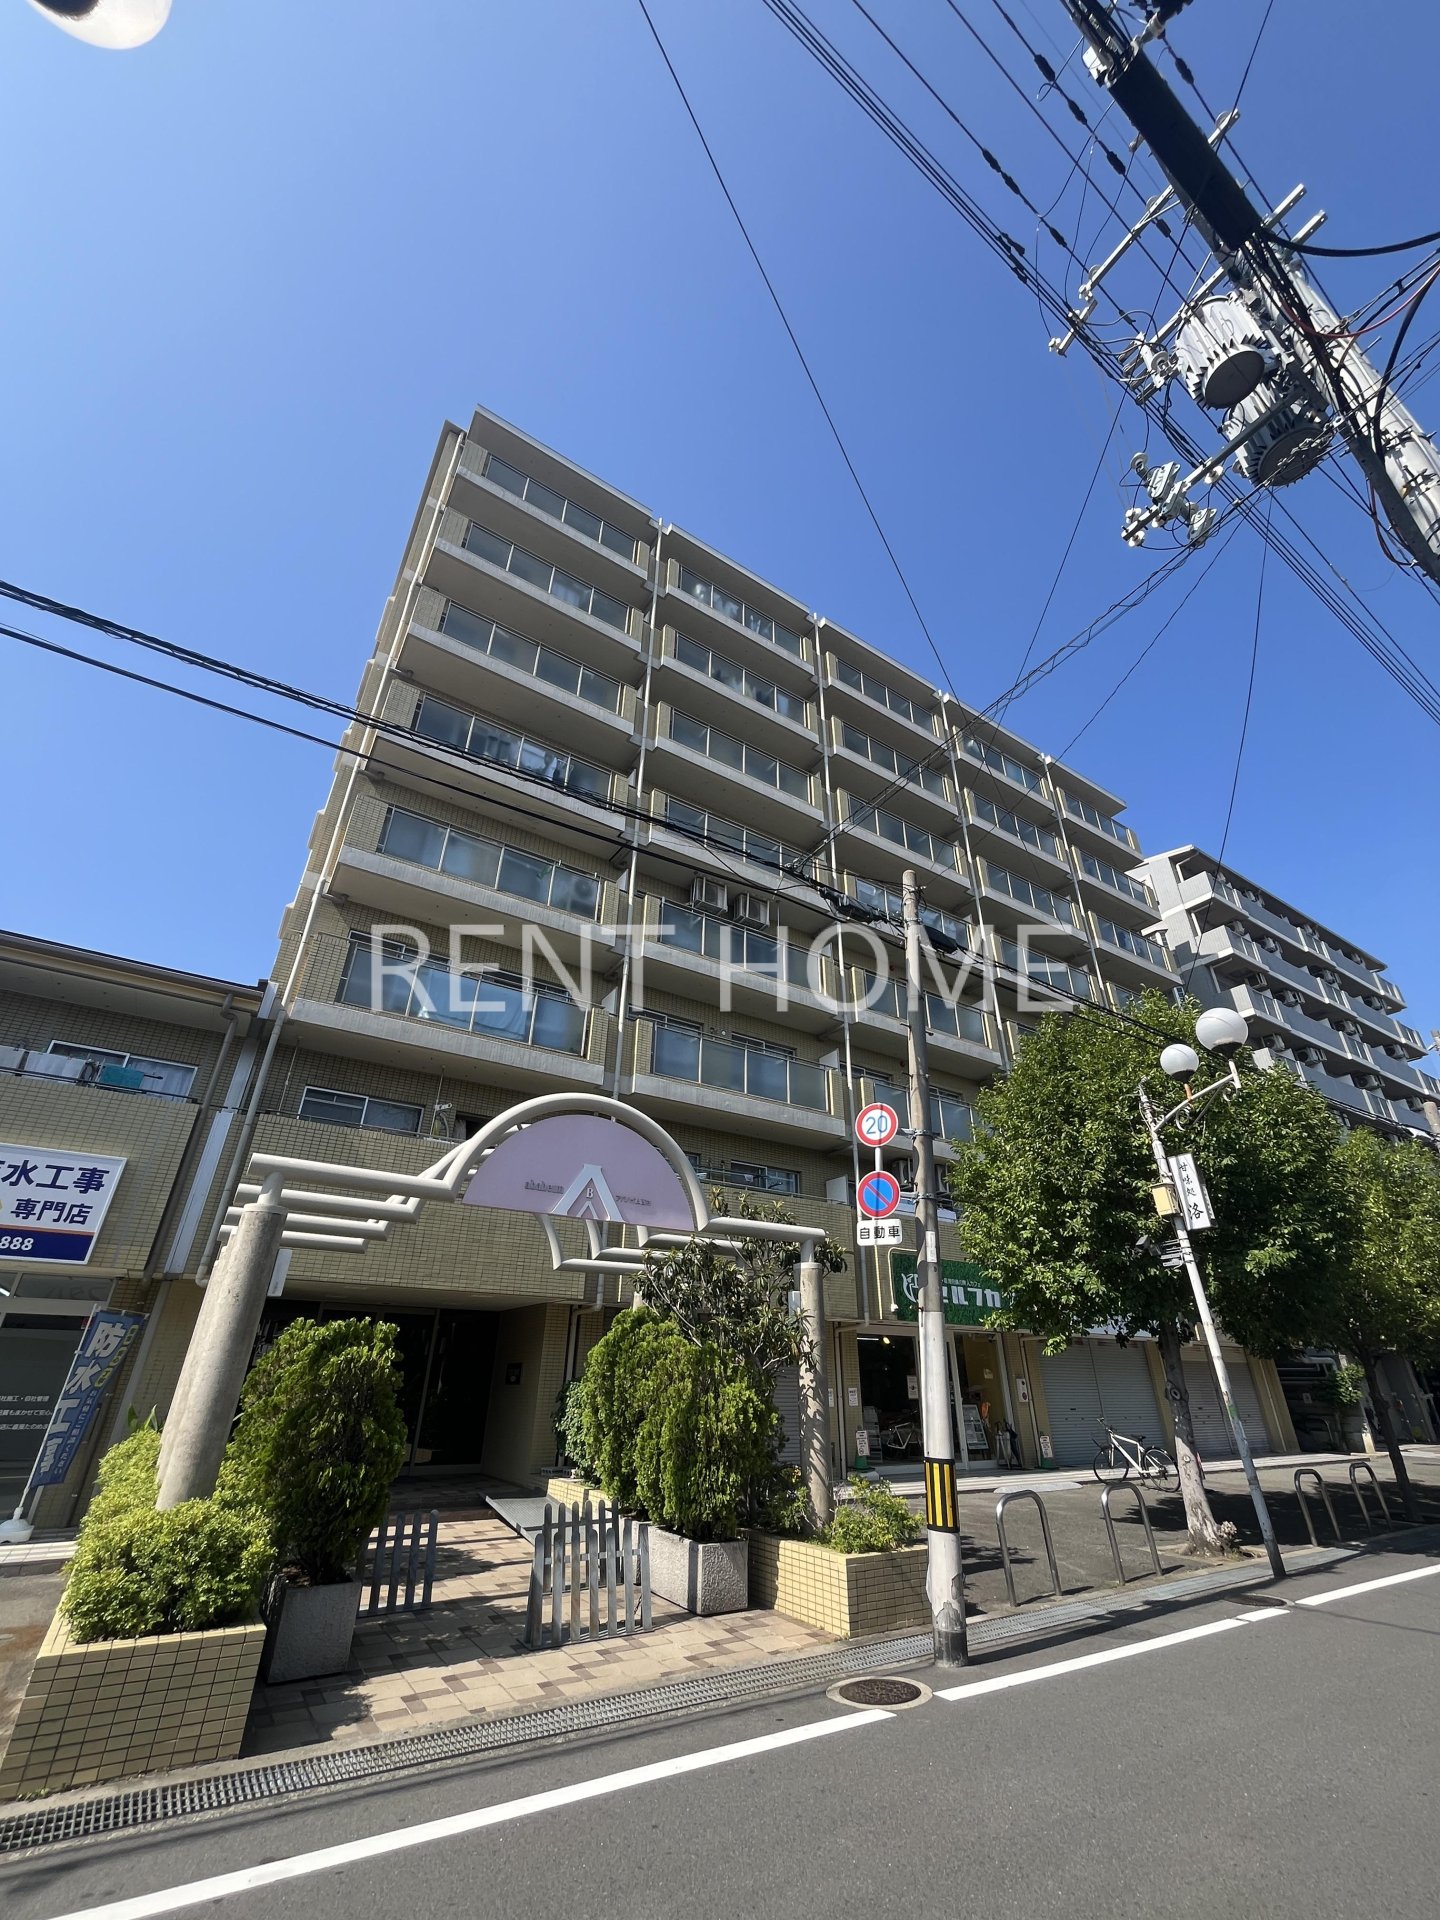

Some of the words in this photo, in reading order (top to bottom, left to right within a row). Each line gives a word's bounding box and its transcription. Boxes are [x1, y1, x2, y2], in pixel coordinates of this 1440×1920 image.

[866, 1115, 888, 1135] 20
[0, 1160, 110, 1194] 水工事
[1179, 1162, 1197, 1196] 甘味処
[1188, 1203, 1204, 1219] 洛
[10, 1198, 93, 1225] 専門店
[859, 1226, 900, 1240] 自動車
[942, 1286, 1016, 1308] ルフカ
[39, 1322, 127, 1474] 防水工事
